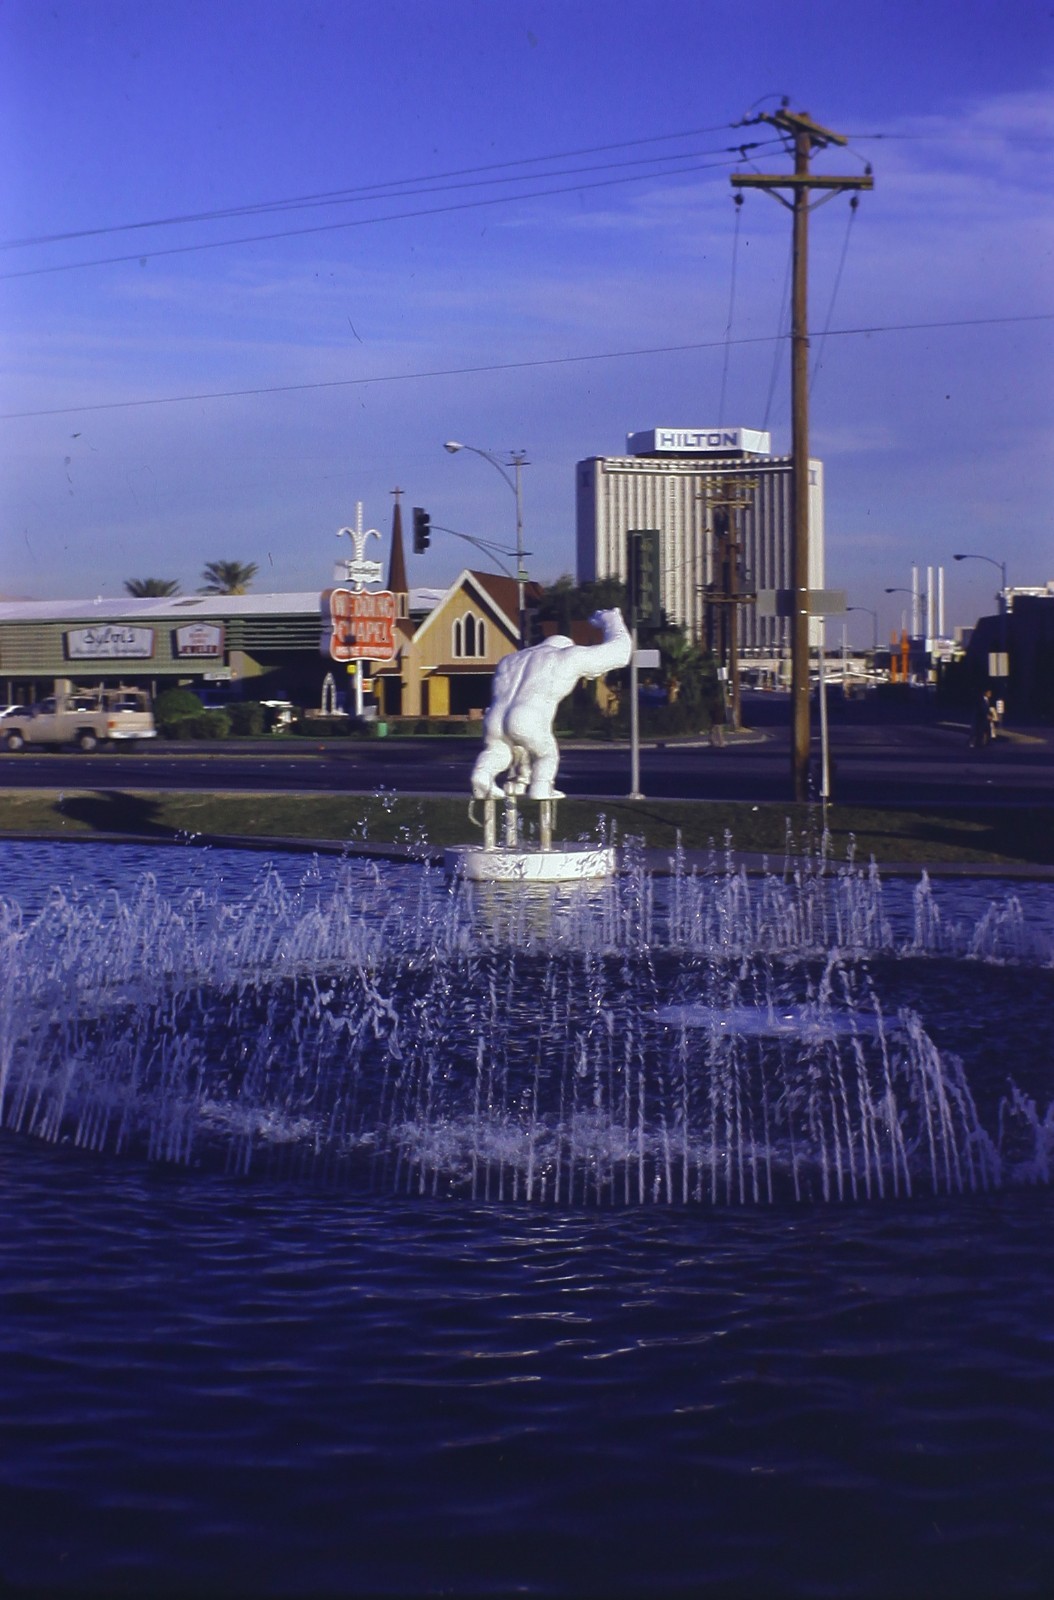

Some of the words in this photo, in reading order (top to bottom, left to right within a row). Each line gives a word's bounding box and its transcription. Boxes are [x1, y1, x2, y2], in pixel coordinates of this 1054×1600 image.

[660, 433, 738, 447] HILTON
[335, 594, 394, 618] WEDDING
[337, 620, 388, 643] CHAPEL
